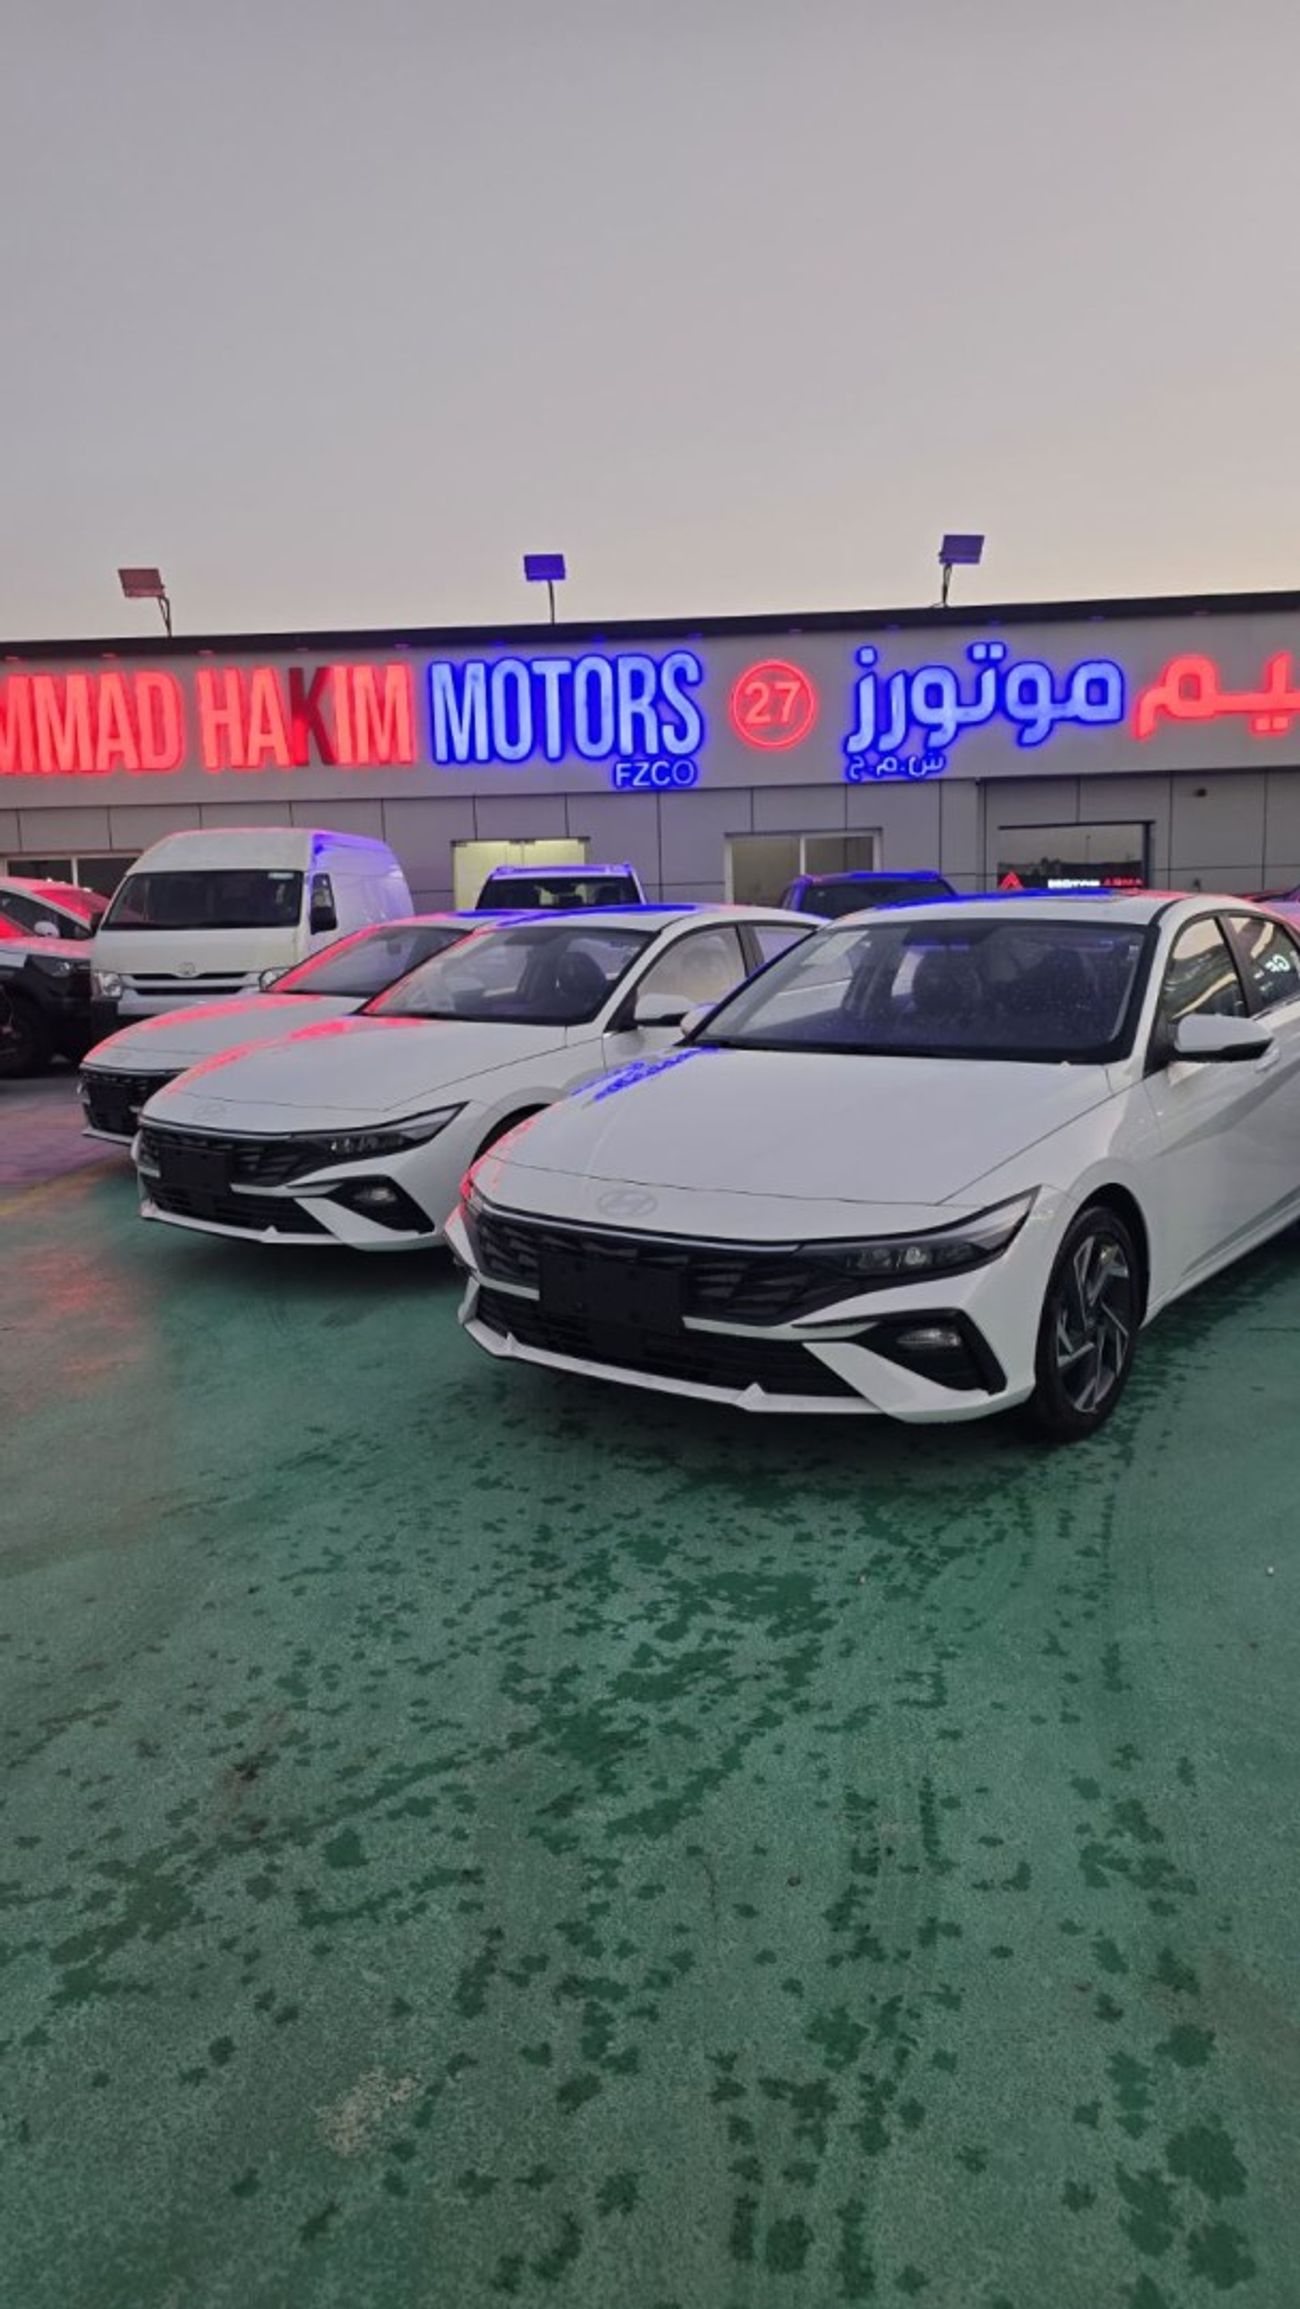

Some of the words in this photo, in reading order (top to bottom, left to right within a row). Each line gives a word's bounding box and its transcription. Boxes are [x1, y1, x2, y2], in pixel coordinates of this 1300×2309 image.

[199, 664, 415, 769] HAKIM
[431, 651, 701, 762] MOTORS
[744, 681, 802, 725] 27
[846, 642, 1123, 752] موتورز
[614, 761, 695, 787] FZCO
